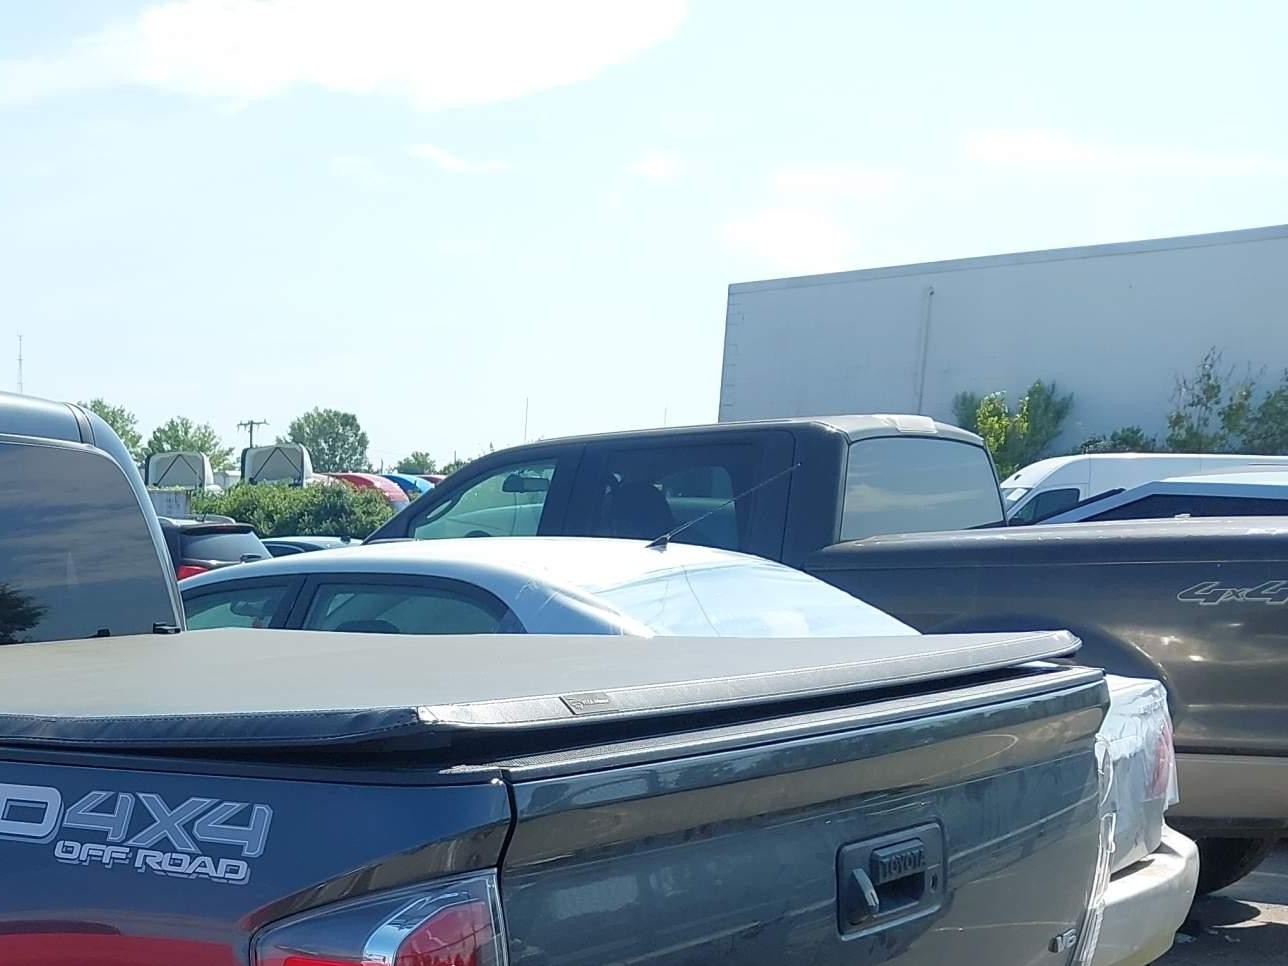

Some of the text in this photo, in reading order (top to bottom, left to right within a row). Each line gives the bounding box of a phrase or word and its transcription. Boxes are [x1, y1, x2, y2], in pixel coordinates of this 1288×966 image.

[53, 839, 252, 886] OFF ROAD
[879, 849, 926, 881] TOYOTA
[1051, 928, 1077, 953] V6
